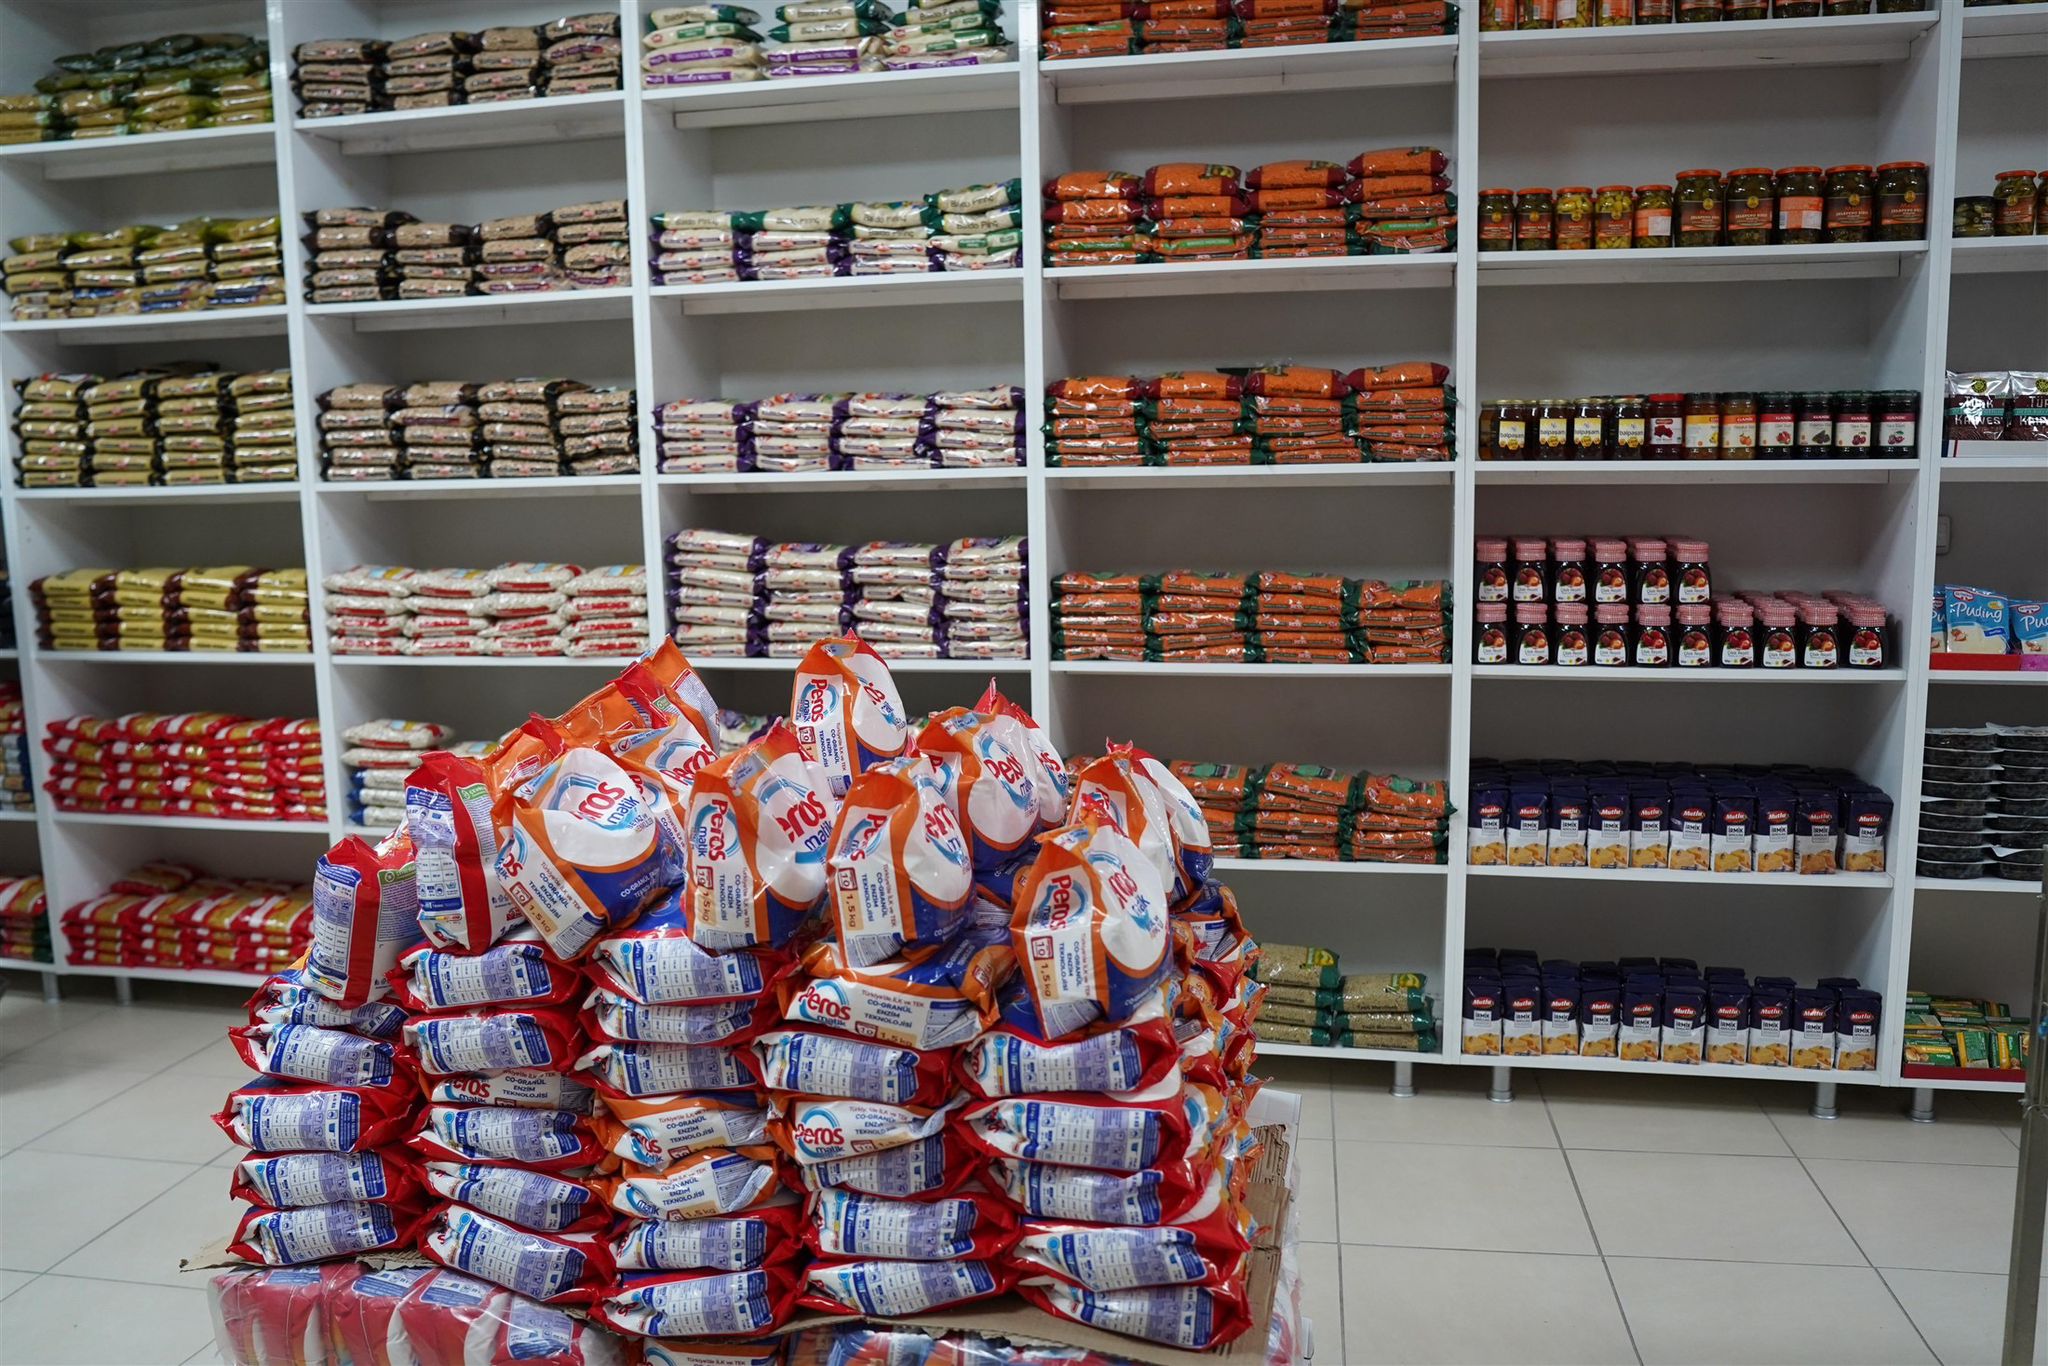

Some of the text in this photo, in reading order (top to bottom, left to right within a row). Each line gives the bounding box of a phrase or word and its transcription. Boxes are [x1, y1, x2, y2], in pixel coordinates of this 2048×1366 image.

[1951, 601, 2003, 623] Puding
[811, 679, 828, 723] Peros
[831, 729, 839, 764] CO-GRANÜL
[572, 781, 626, 820] ros
[607, 796, 640, 825] matik
[708, 799, 728, 862] Peros
[804, 820, 834, 851] matik
[698, 826, 708, 857] matik
[840, 872, 849, 887] 10
[514, 888, 526, 903] 10
[529, 880, 562, 919] TEKNOLOJİSİ
[539, 872, 569, 908] CO-GRANÜL
[540, 884, 557, 906] ENZİM
[719, 874, 728, 921] TEKNOLOJİSİ
[862, 874, 875, 922] TEKNOLOJİSİ
[870, 884, 878, 908] ENZİM
[876, 872, 887, 918] CO-GRANÜL
[1051, 874, 1071, 931] Peros
[849, 915, 856, 928] kg
[1039, 941, 1046, 957] 10
[1058, 942, 1069, 992] TEKNOLOJİSİ
[1073, 940, 1081, 988] CO-GRANÜL
[1043, 983, 1051, 999] kg
[799, 986, 851, 1020] Peros
[867, 999, 913, 1013] CO-GRANÜL
[816, 1014, 846, 1027] matik
[864, 1012, 913, 1028] TEKNOLOJİSİ
[876, 1009, 900, 1018] ENZİM
[860, 1026, 875, 1036] 10
[505, 1075, 547, 1086] CO-GRANÜL
[513, 1084, 536, 1092] ENZİM
[502, 1088, 549, 1099] TEKNOLOJİSİ
[666, 1115, 707, 1130] CO-GRANÜL
[677, 1125, 699, 1135] ENZİM
[670, 1128, 715, 1144] TEKNOLOJİSİ
[794, 1124, 844, 1146] Peros
[815, 1144, 845, 1154] matik
[662, 1190, 705, 1206] TEKNOLOJİSİ
[669, 1187, 691, 1197] ENZİM
[703, 1207, 717, 1217] kg
